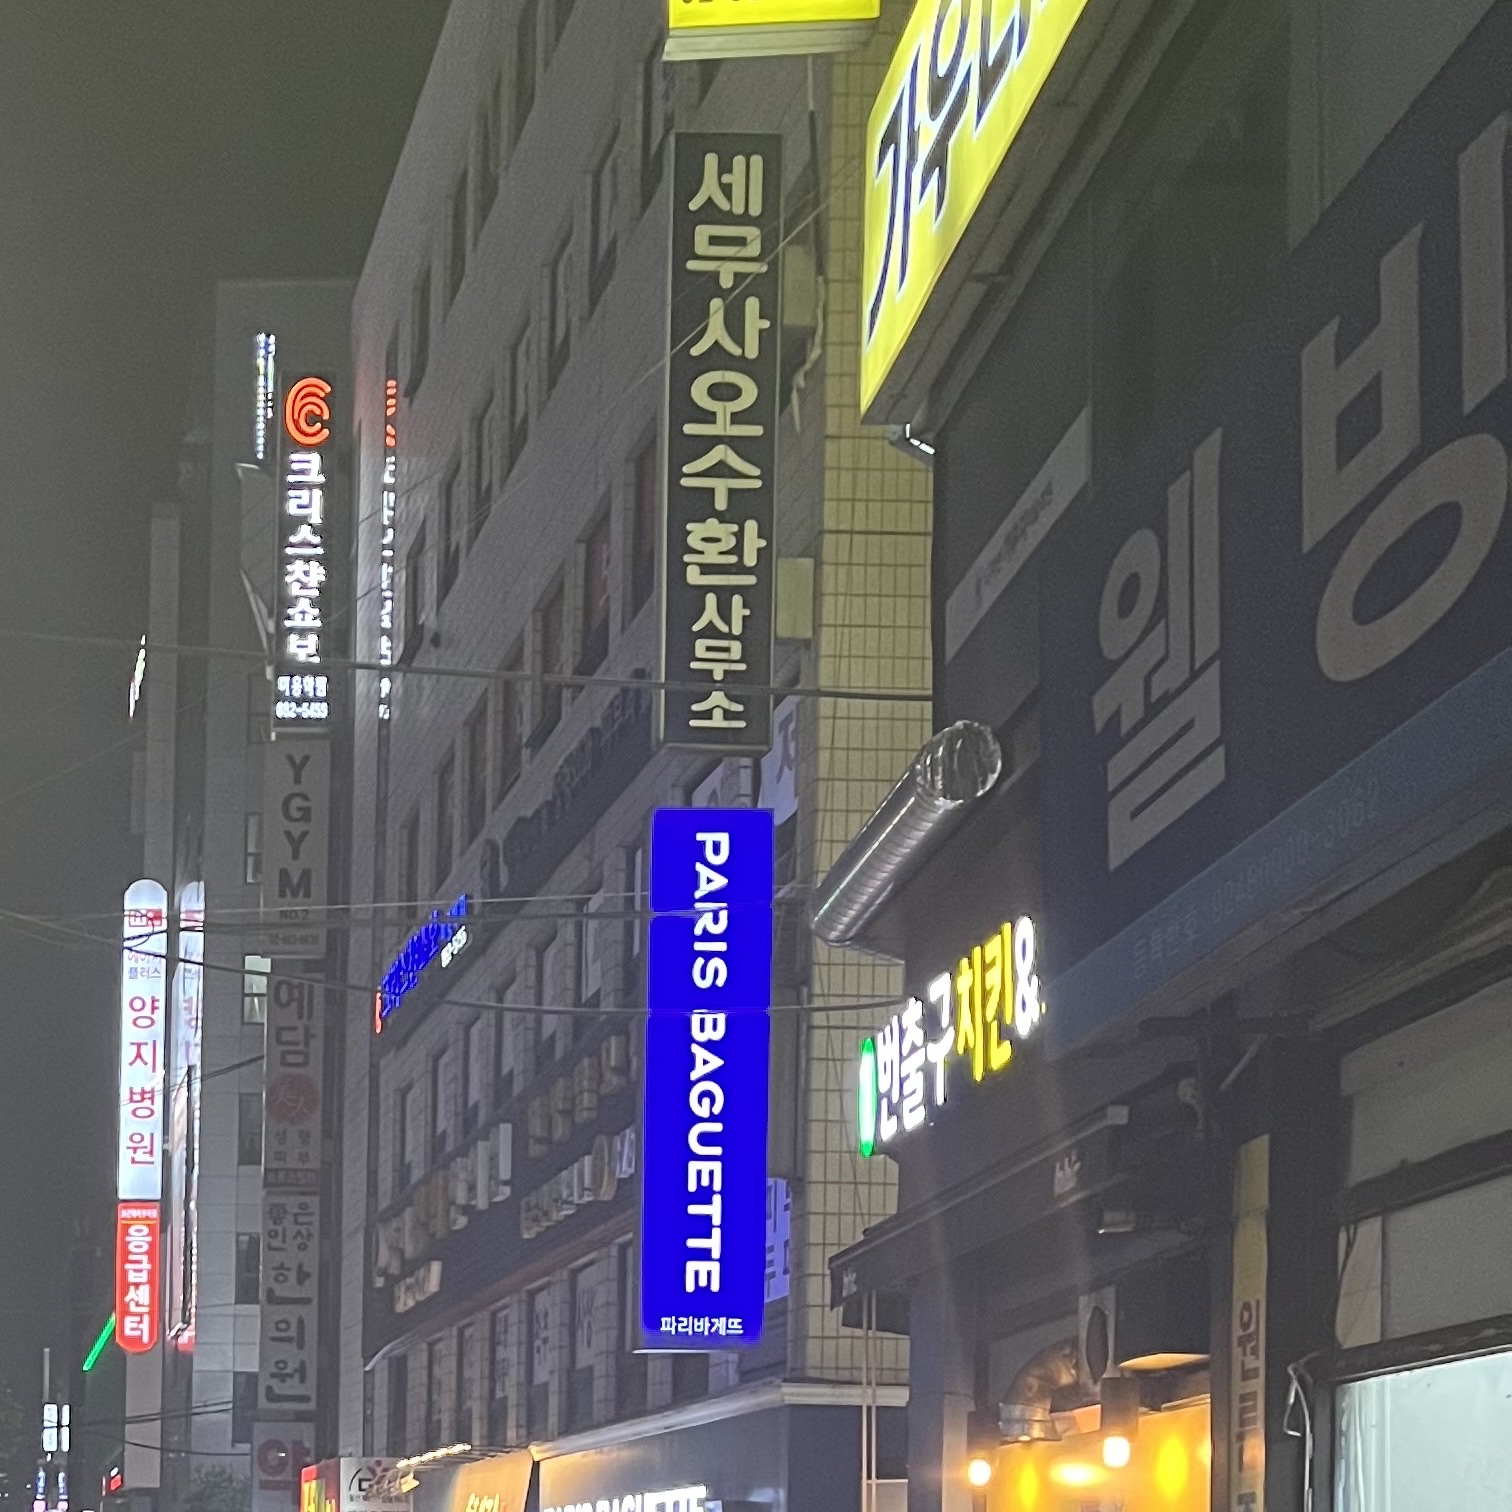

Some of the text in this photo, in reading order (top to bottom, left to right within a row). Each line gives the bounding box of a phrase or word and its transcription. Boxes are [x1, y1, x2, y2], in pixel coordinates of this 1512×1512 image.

[277, 753, 312, 899] YGYM
[690, 831, 730, 989] PARIS
[128, 995, 161, 1167] 양지병원
[684, 1009, 726, 1295] BAGUETTE
[123, 1224, 153, 1344] 응급센터
[265, 1261, 313, 1404] 한의원
[659, 1314, 745, 1337] 파리바게뜨
